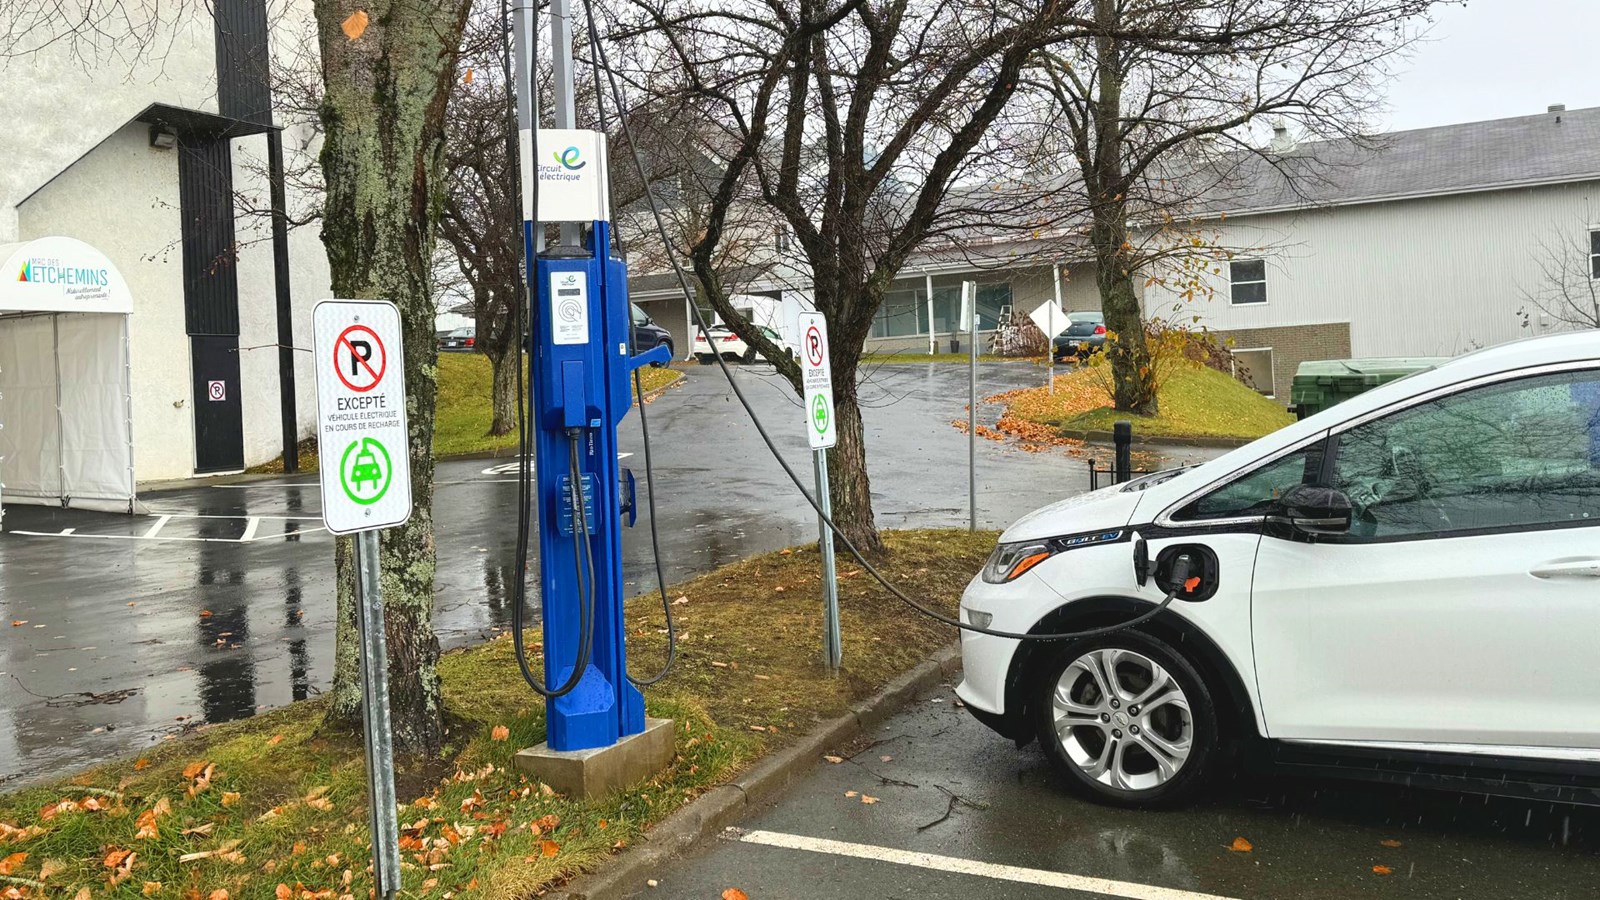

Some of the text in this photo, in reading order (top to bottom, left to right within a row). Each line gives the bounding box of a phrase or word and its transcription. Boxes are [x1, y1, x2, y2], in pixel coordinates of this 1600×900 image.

[540, 172, 580, 181] électrique
[47, 258, 59, 266] DES
[32, 266, 108, 286] ETCHEMINS
[350, 340, 372, 376] P
[337, 393, 386, 410] EXCEPTÉ
[327, 410, 397, 421] VÉHICULE ÉLECTRIQUE
[335, 423, 357, 432] COURS
[358, 422, 367, 430] DE
[368, 420, 400, 429] RECHARGE
